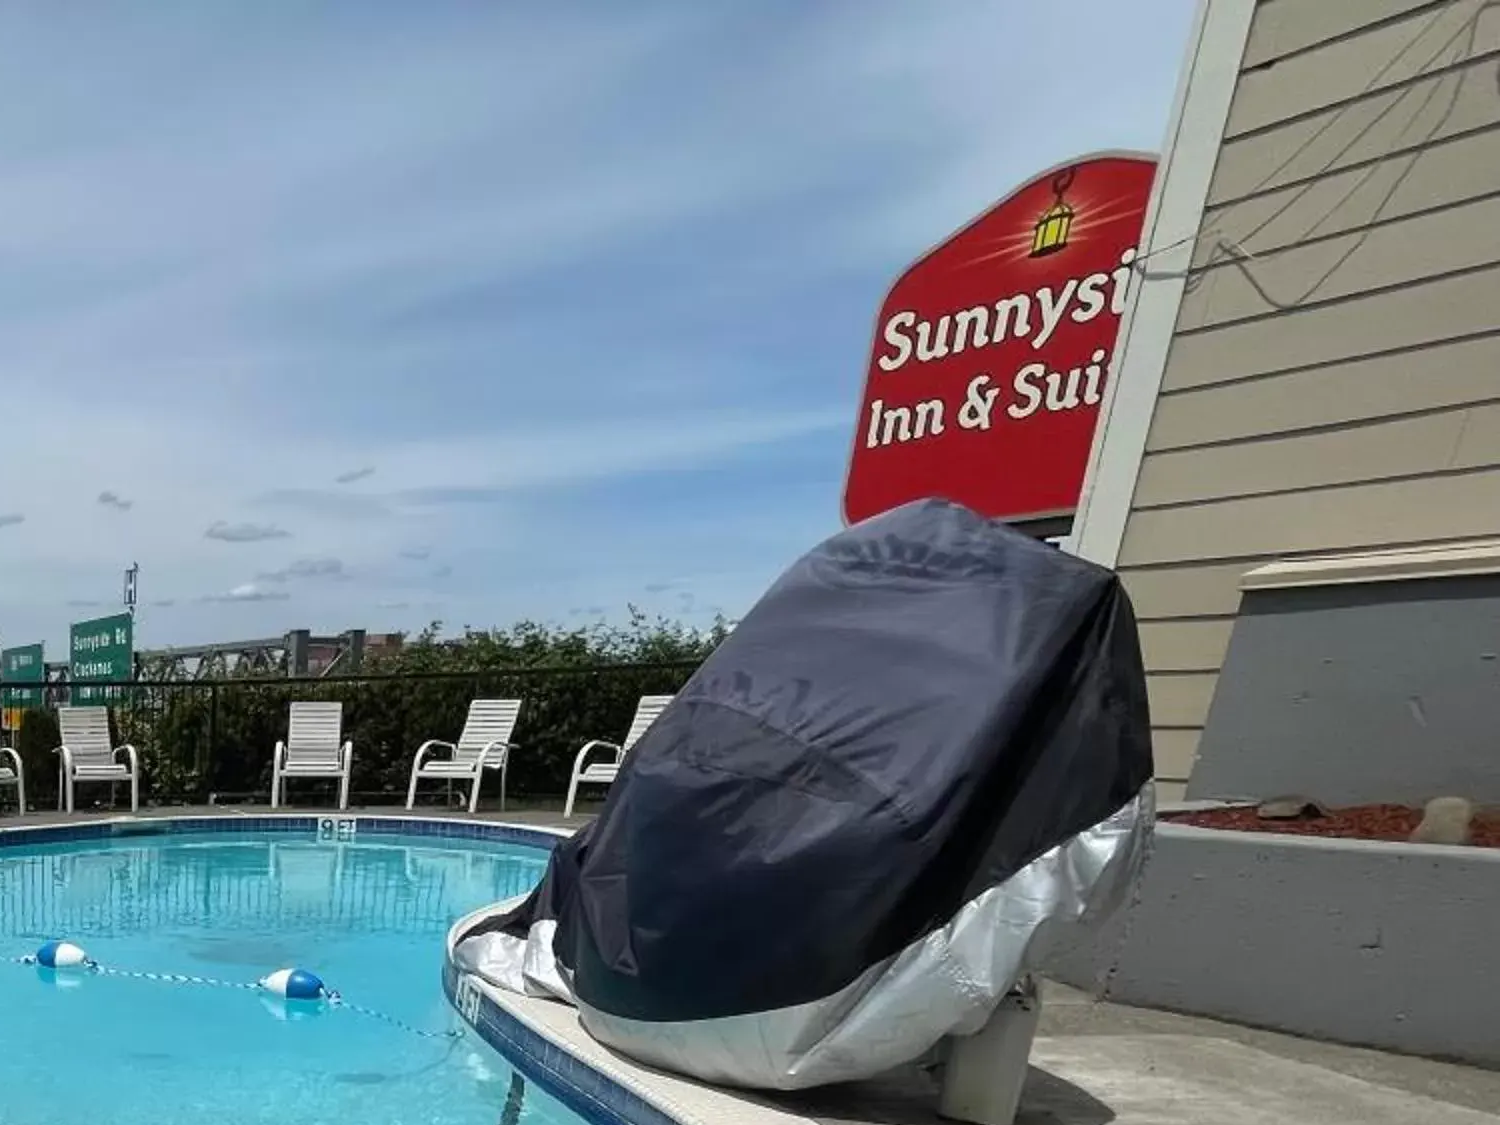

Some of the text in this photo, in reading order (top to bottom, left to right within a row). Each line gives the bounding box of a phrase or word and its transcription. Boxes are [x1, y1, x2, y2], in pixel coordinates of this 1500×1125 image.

[878, 246, 1134, 372] Sunnysi
[866, 348, 1109, 449] Inn & Sui
